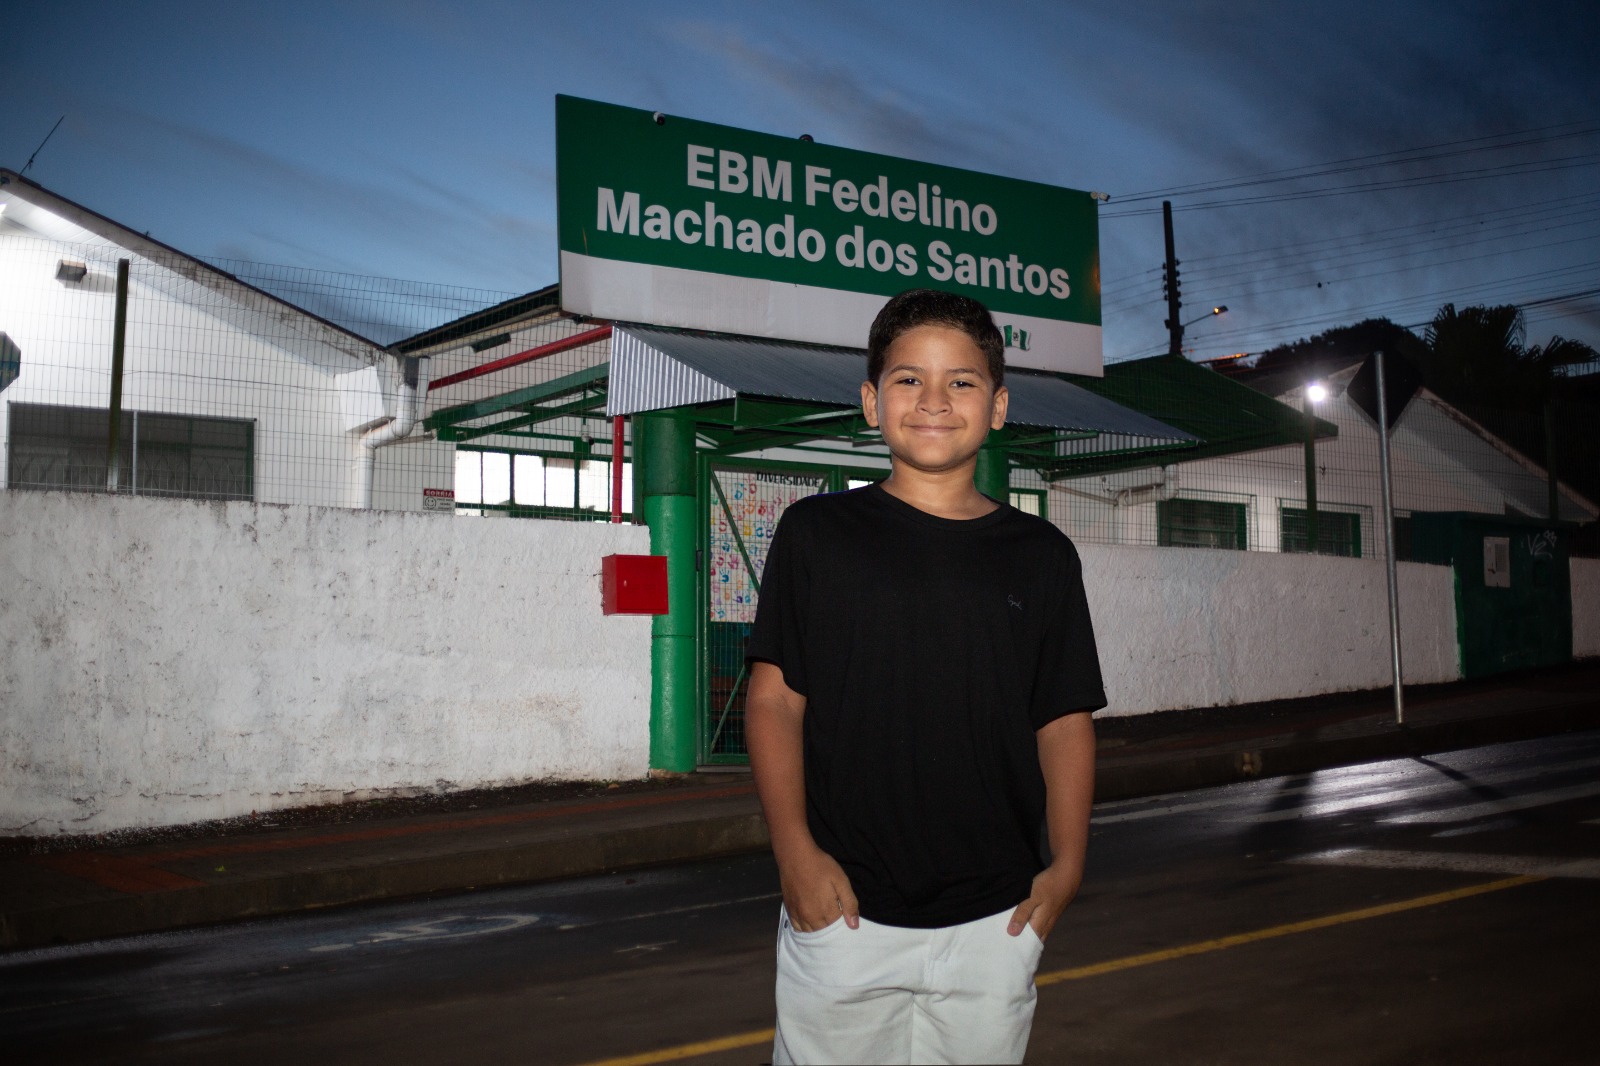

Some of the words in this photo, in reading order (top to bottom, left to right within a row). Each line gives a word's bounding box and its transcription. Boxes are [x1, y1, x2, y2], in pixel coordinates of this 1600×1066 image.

[687, 143, 793, 203] EBM
[805, 164, 998, 236] Fedelino
[596, 186, 827, 263] Machado
[835, 225, 919, 276] dos
[927, 240, 1071, 300] Santos
[425, 490, 453, 498] SORRIA
[756, 471, 820, 487] DIVERSIDADE
